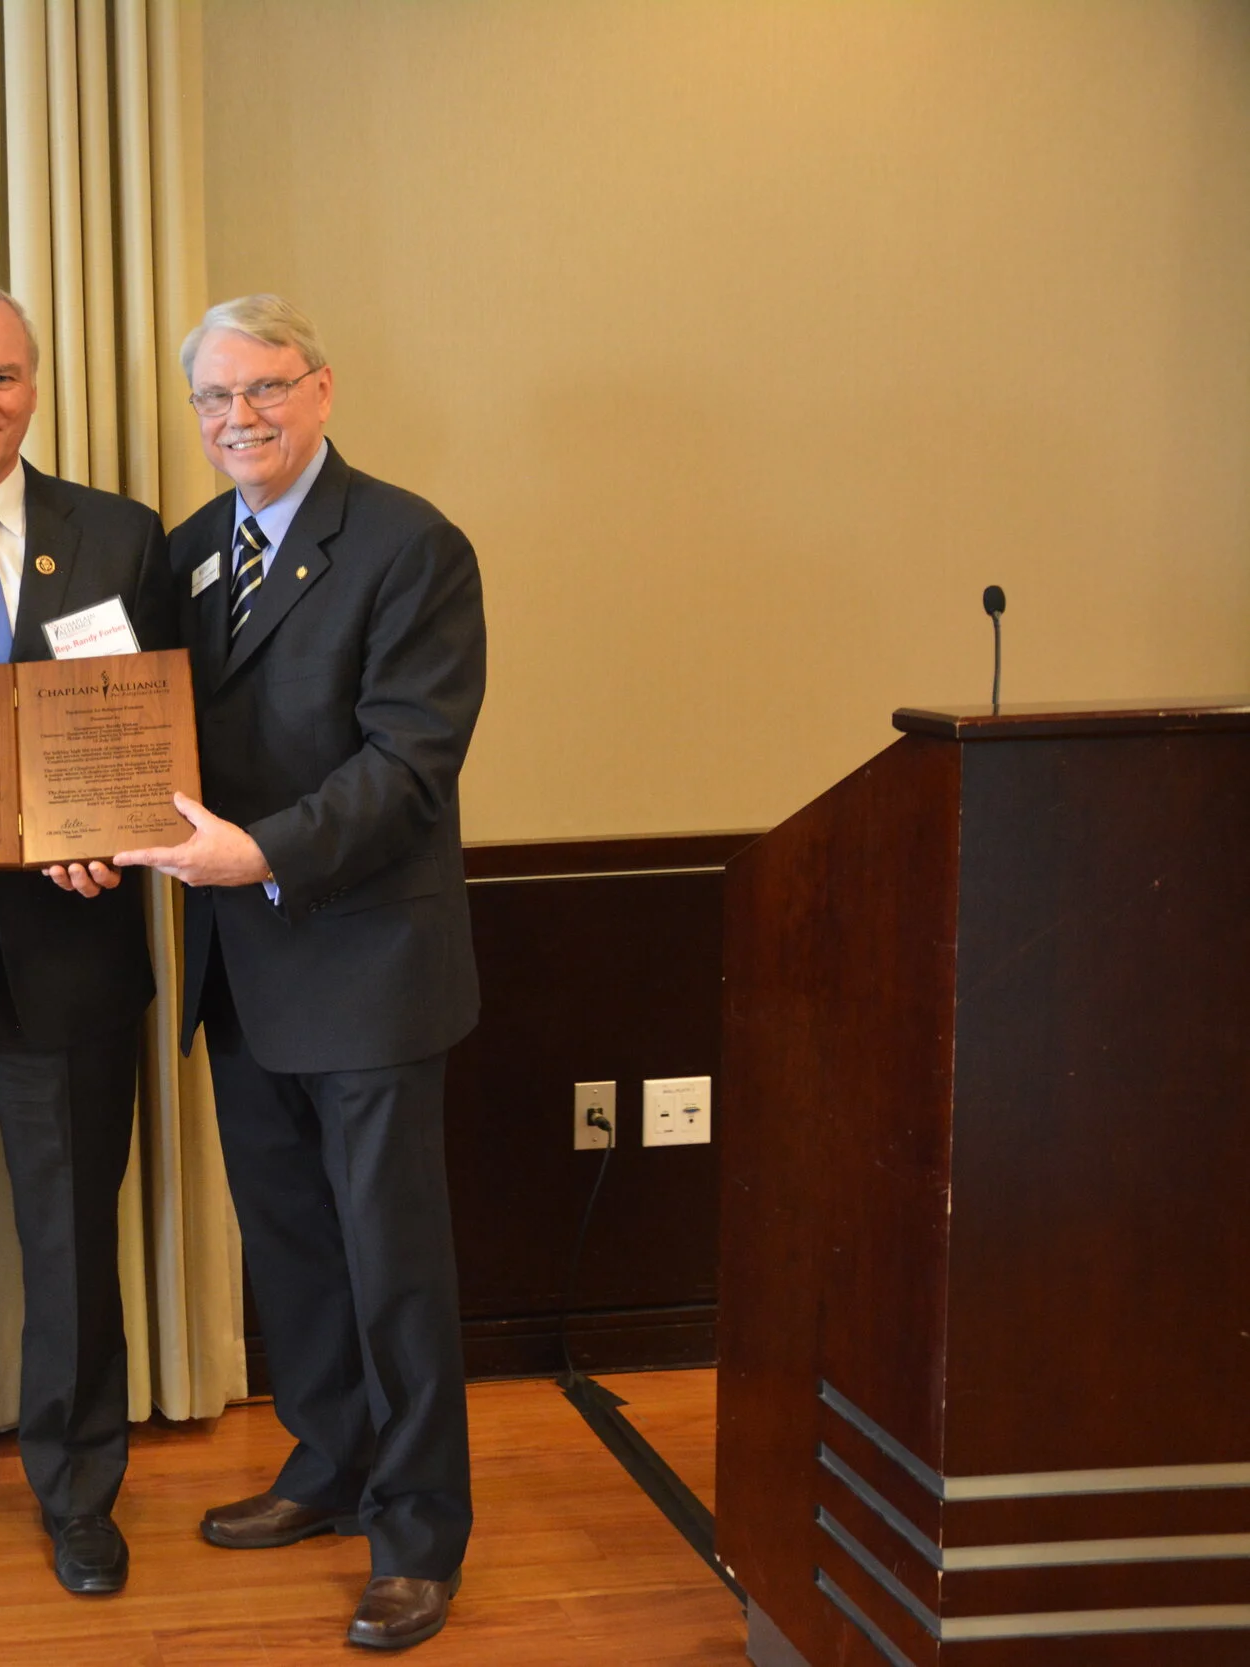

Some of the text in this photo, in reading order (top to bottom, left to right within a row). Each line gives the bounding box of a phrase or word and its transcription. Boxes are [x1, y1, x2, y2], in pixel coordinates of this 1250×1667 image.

[55, 644, 72, 653] Rep.
[73, 634, 97, 647] Randy
[99, 624, 126, 637] Forbes
[37, 679, 169, 698] CHAPLAIN ALLIANCE
